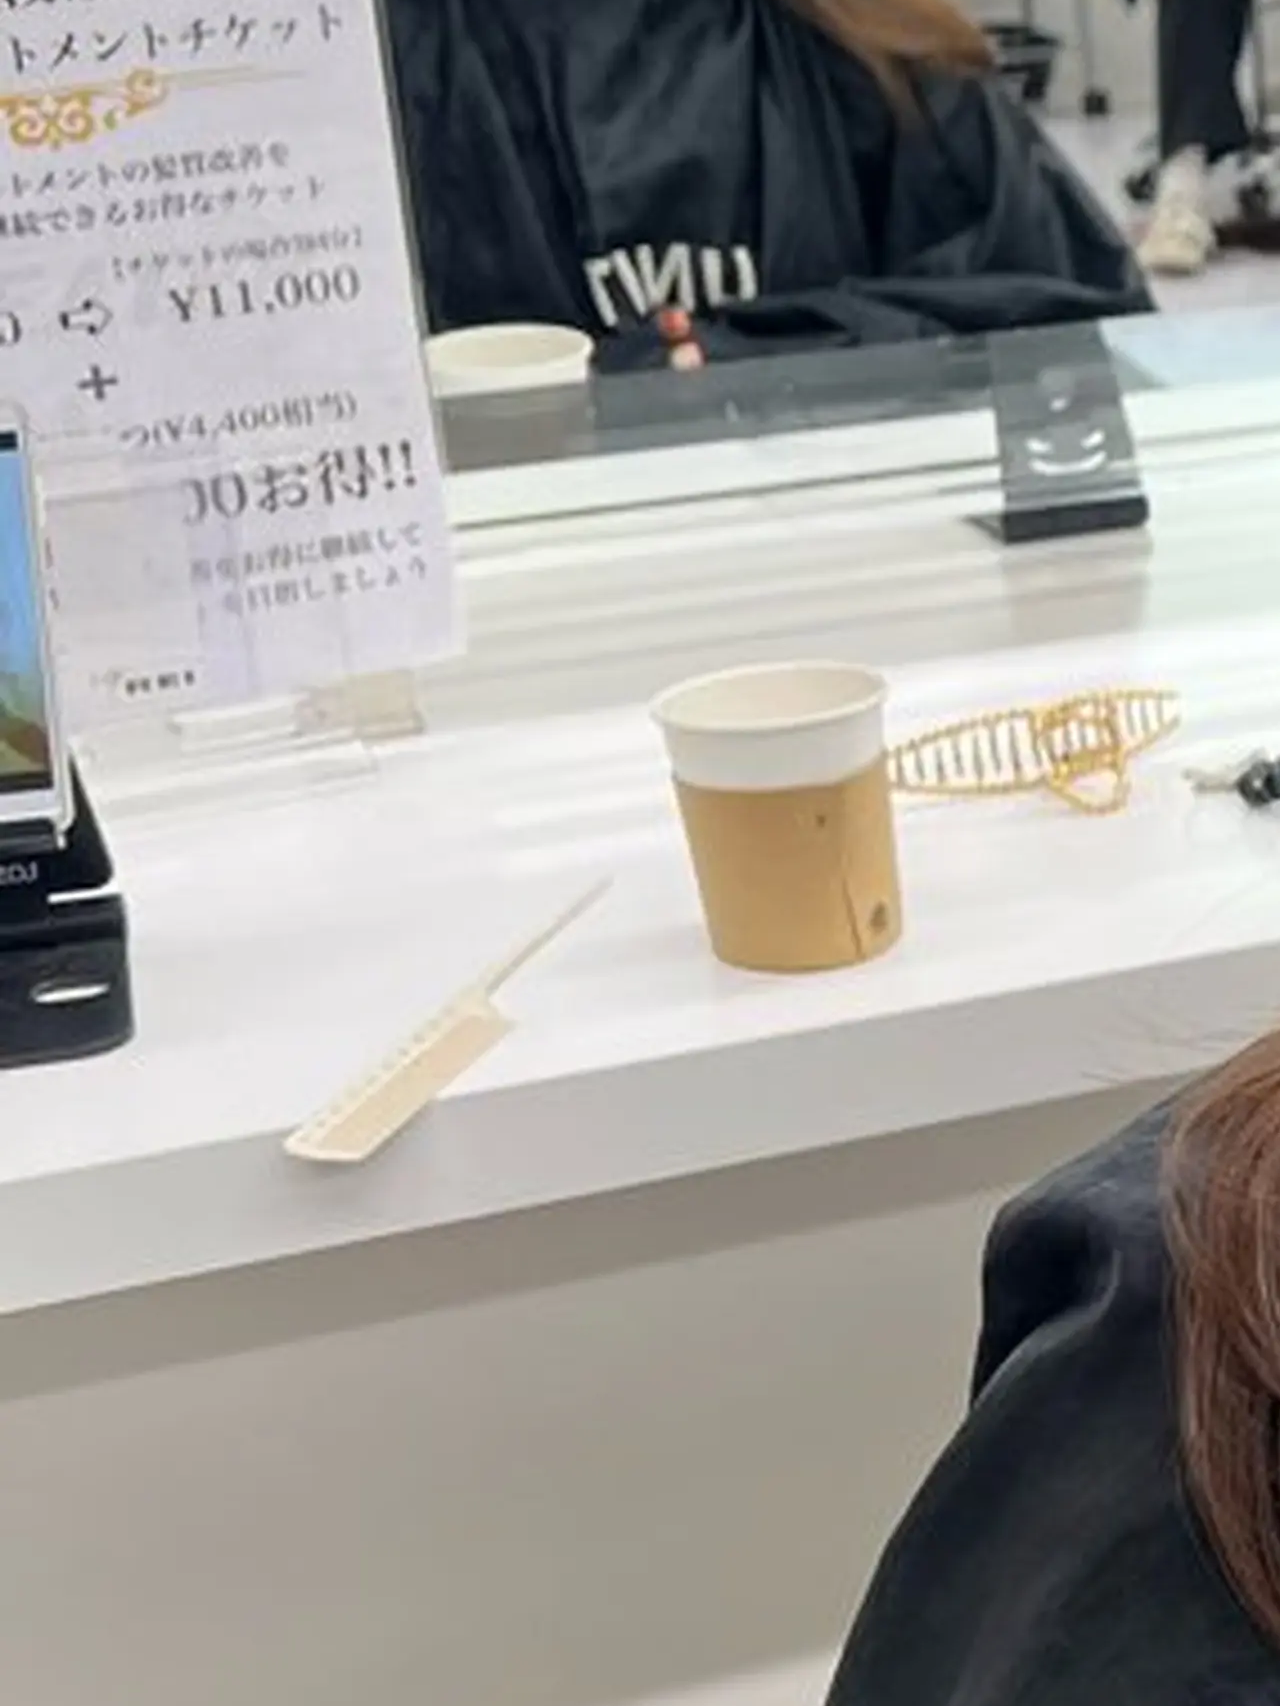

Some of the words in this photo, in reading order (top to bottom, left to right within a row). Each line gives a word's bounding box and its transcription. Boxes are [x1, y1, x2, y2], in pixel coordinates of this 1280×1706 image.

[10, 4, 342, 74] トメントチケット
